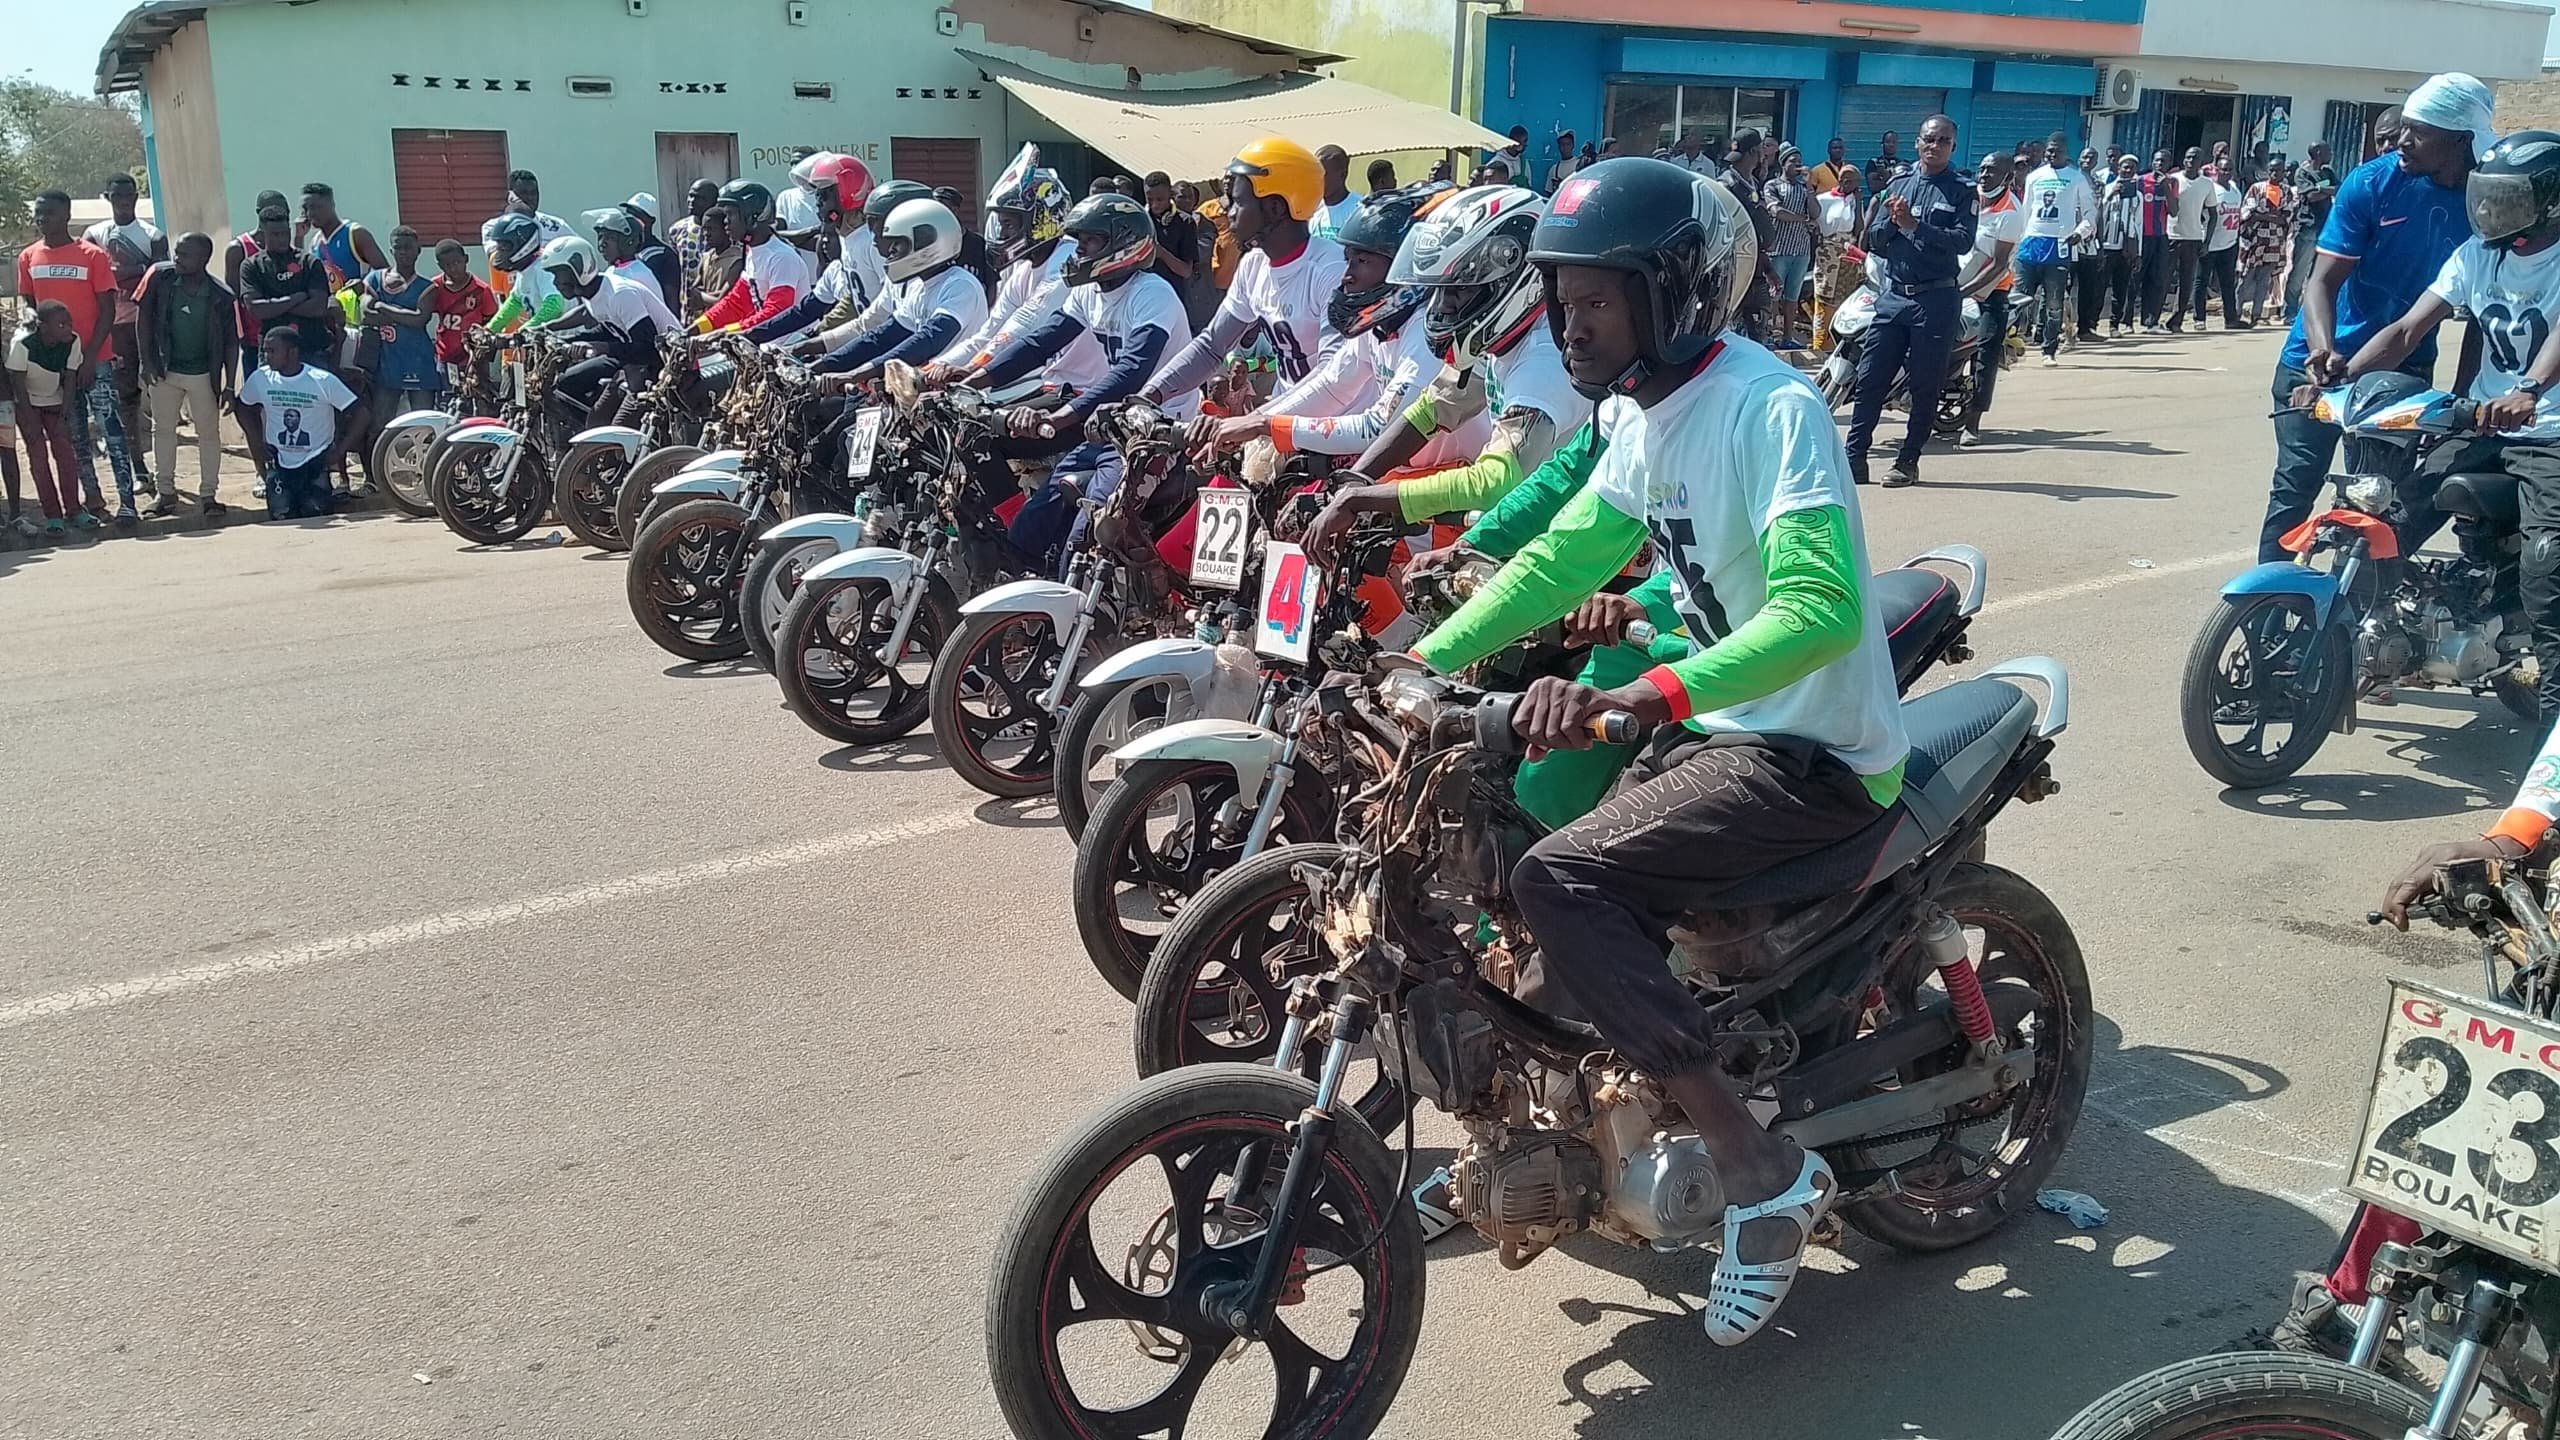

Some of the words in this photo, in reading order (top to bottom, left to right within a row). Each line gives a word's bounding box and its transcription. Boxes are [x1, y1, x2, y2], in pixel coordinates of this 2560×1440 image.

[750, 143, 879, 169] POISNERIE
[443, 314, 462, 330] 42
[1198, 506, 1242, 563] 22
[1195, 562, 1237, 576] BOUAKE
[1266, 553, 1309, 644] 4
[2374, 1035, 2560, 1208] 23
[2364, 1155, 2543, 1244] BOUAKE
